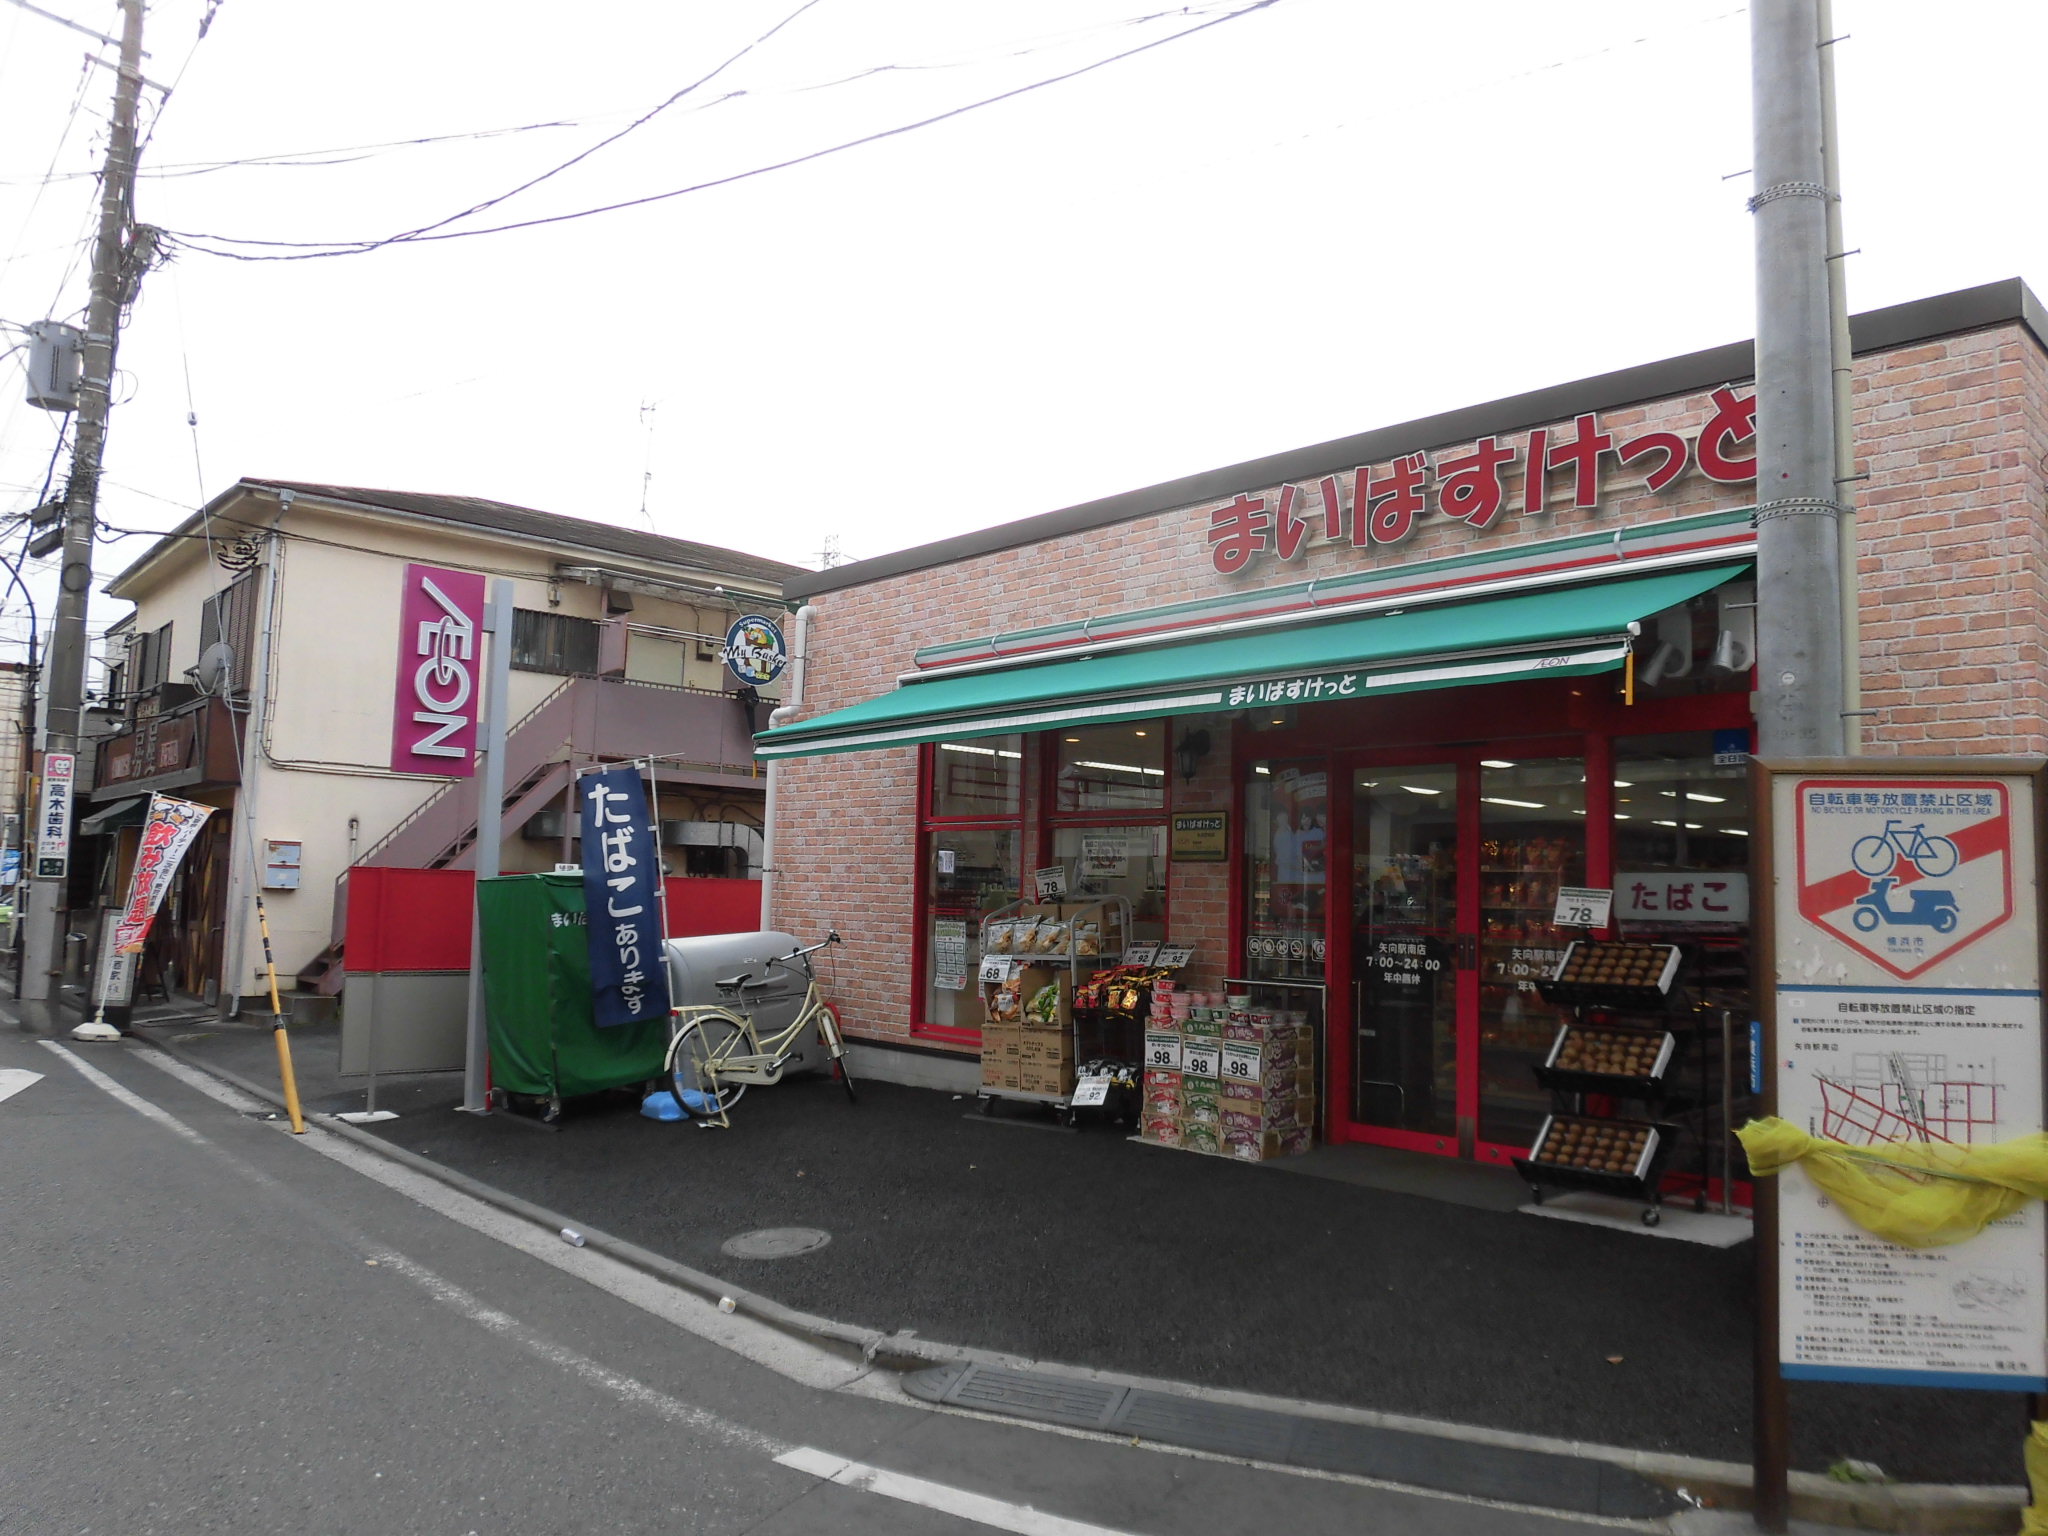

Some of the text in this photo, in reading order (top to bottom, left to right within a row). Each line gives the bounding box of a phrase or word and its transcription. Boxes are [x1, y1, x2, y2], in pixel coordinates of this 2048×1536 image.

[1207, 384, 1757, 576] まいばすけっと
[739, 618, 777, 634] Supermarket
[723, 645, 746, 660] My
[411, 576, 473, 757] AEON
[1533, 657, 1570, 669] AEON
[1229, 674, 1357, 706] まいばすけっと
[1809, 793, 1992, 807] 自転車等放置禁止区域
[46, 783, 67, 839] 高木歯科
[1824, 806, 1851, 814] BICYCLE
[1854, 806, 1863, 814] OR
[1866, 806, 1912, 815] MOTORCYCLE
[1915, 807, 1944, 815] PARKING
[1956, 807, 1970, 815] THIS
[124, 821, 180, 926] 飲み放題
[1044, 882, 1058, 893] 78
[1631, 882, 1729, 912] たばこ
[1569, 907, 1592, 922] 78
[1379, 942, 1426, 956] 矢向駅南店
[986, 967, 1000, 979] 68
[1384, 972, 1420, 985] 年中無休
[1839, 1003, 1976, 1016] 自転車等放置禁止区域の指定
[1154, 1051, 1170, 1064] 98
[1191, 1058, 1208, 1073] 98
[1230, 1061, 1248, 1077] 98
